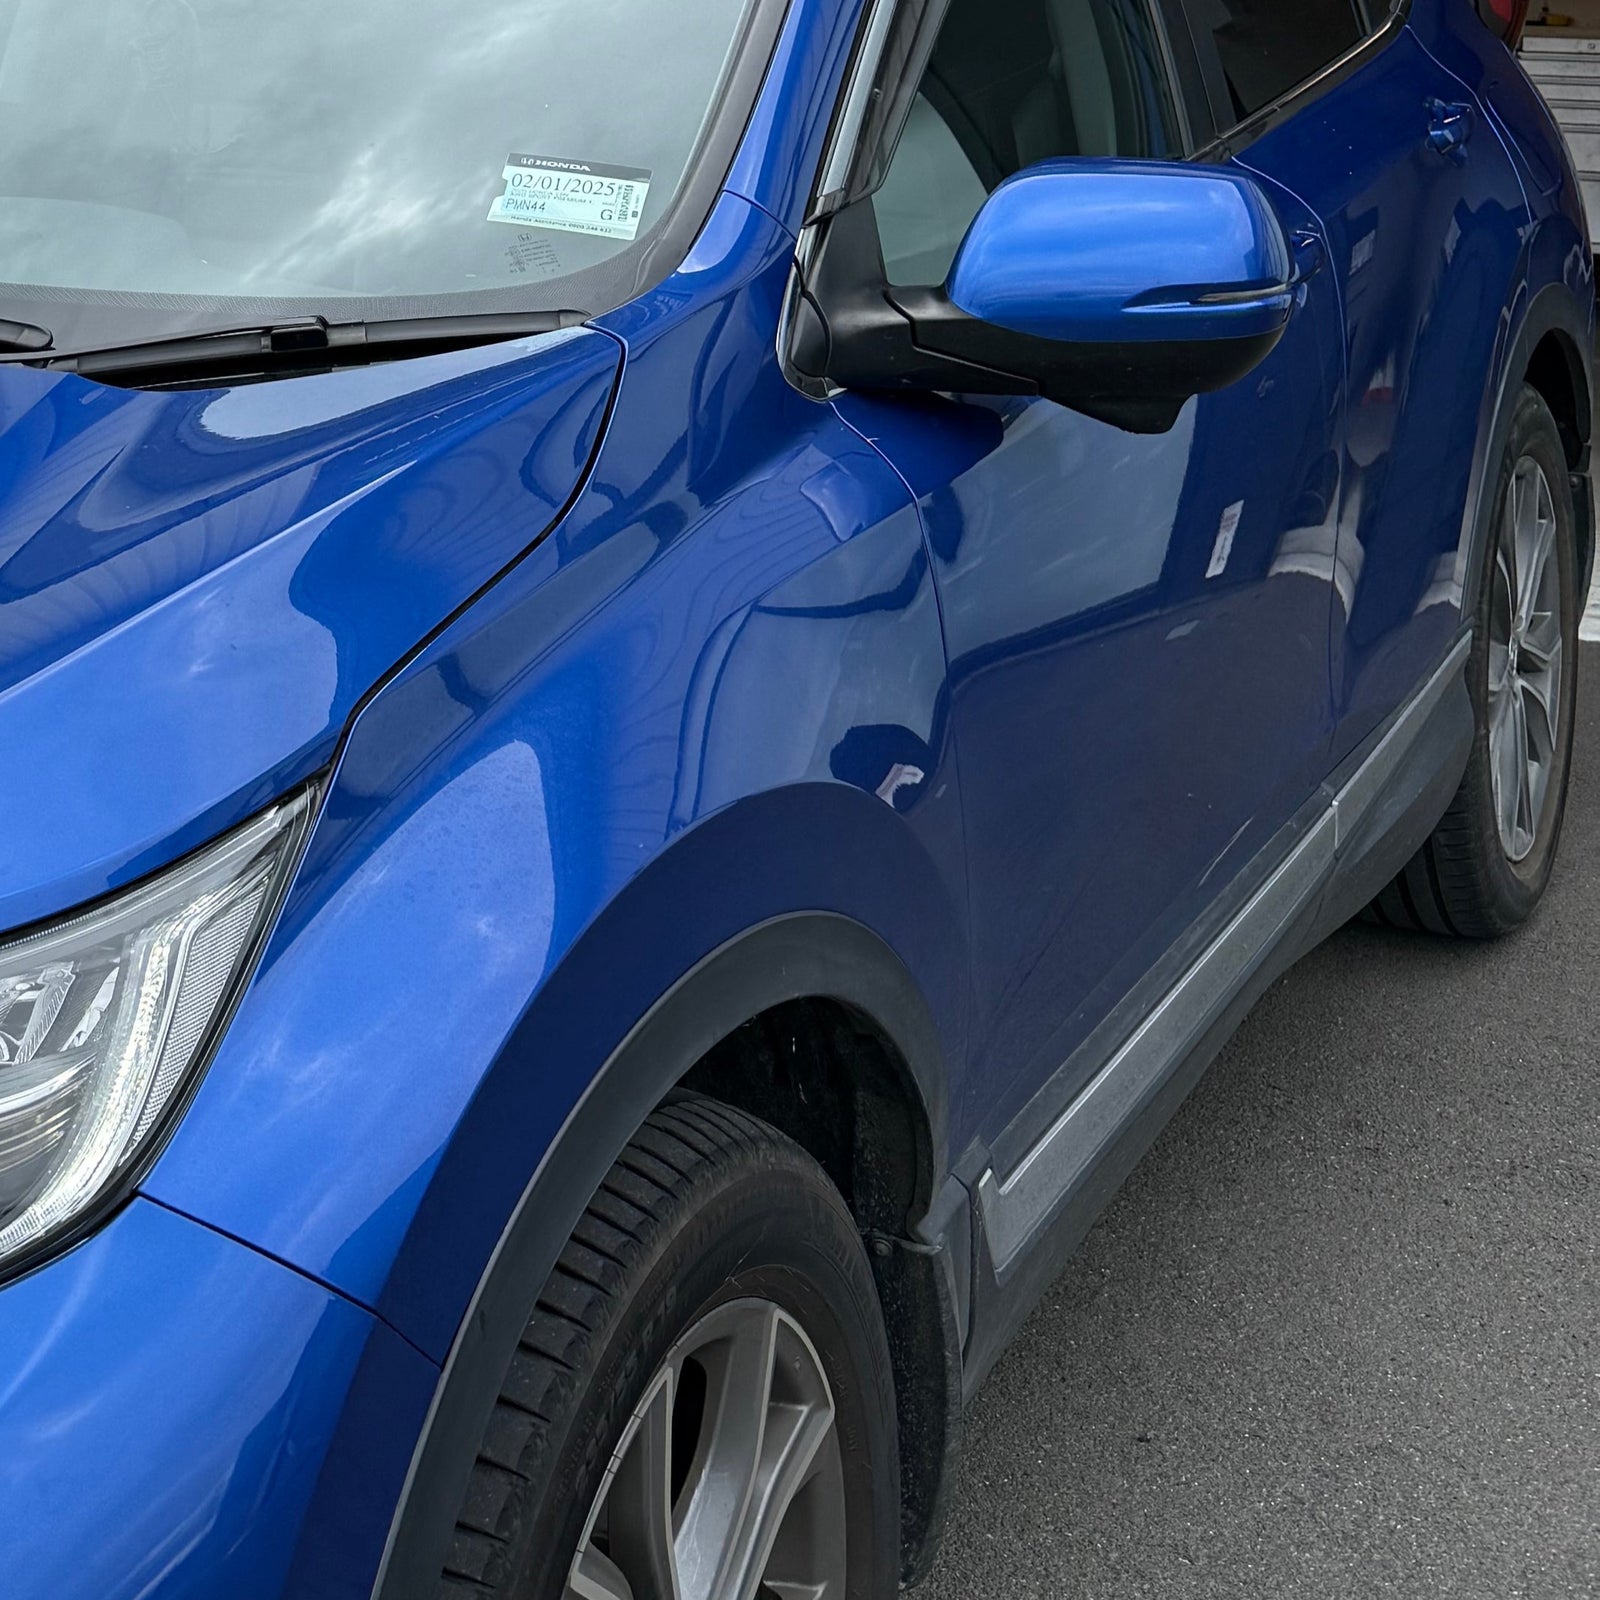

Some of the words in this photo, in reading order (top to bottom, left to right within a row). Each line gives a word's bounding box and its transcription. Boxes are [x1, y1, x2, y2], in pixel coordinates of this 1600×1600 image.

[534, 159, 592, 173] HONDA
[510, 172, 617, 198] 02/01/2025
[600, 208, 614, 222] G
